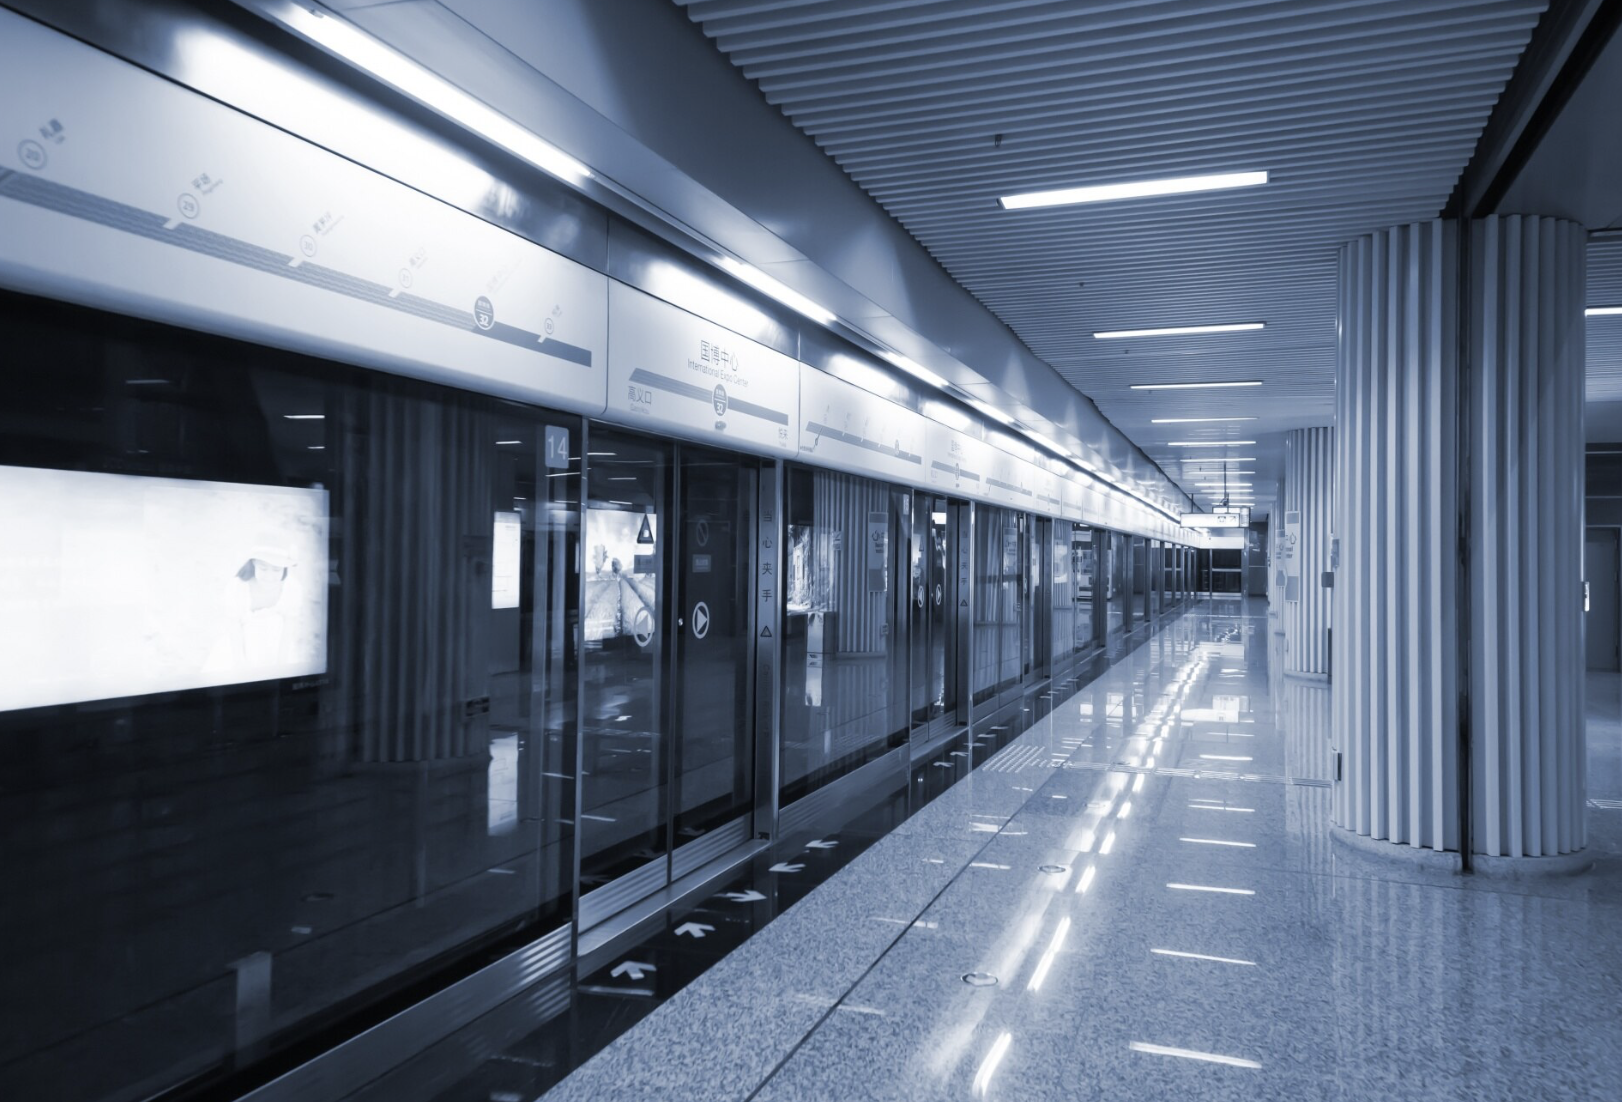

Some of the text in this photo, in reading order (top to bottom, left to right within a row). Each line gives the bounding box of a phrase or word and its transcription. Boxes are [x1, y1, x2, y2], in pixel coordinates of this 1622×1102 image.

[479, 313, 489, 327] 32
[700, 340, 739, 372] 国博中心
[687, 358, 749, 388] International Expo Center
[627, 385, 652, 405] 高义口
[716, 402, 723, 414] 32
[548, 435, 568, 460] 14
[762, 511, 773, 602] 当心夹手
